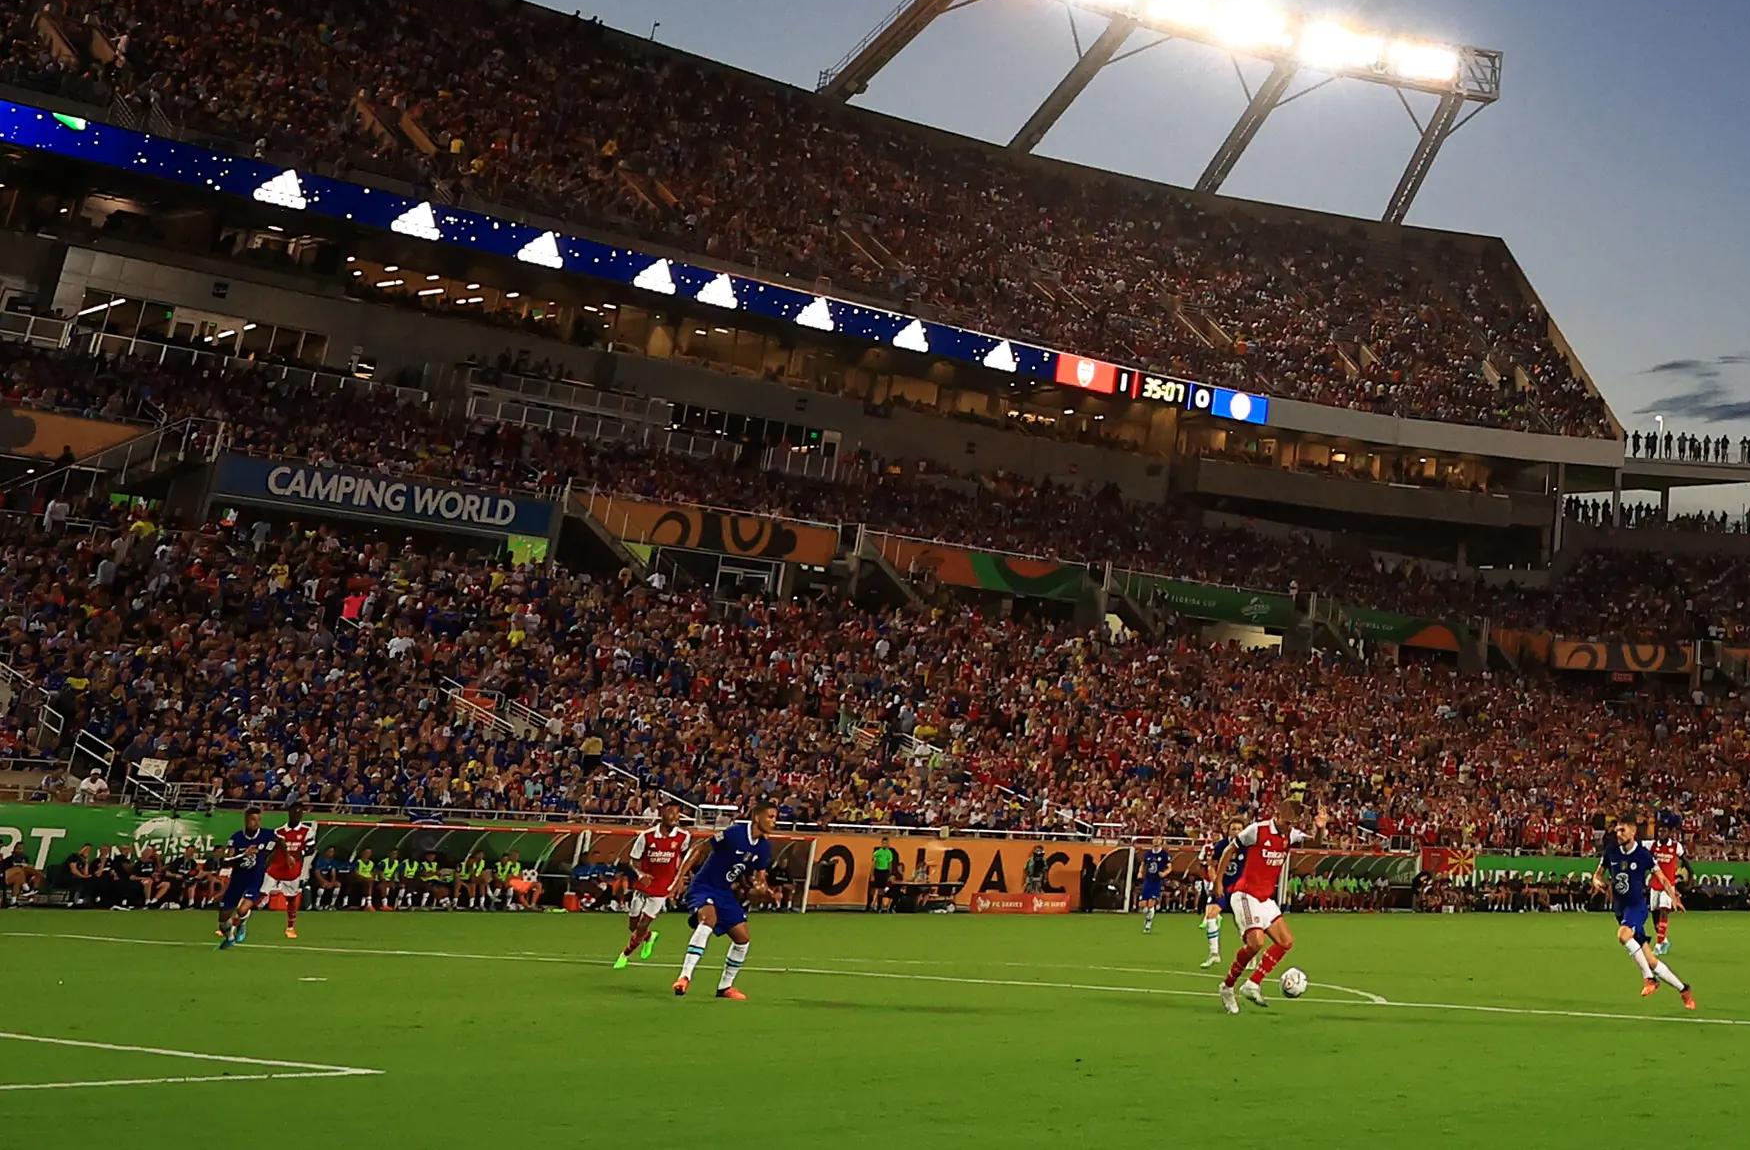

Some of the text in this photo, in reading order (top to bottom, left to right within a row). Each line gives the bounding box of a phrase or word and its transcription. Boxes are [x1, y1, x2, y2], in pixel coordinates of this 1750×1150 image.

[1142, 377, 1185, 402] 35:07
[1195, 389, 1210, 408] 0
[267, 466, 516, 526] CAMPING WORLD
[1615, 872, 1629, 895] 3
